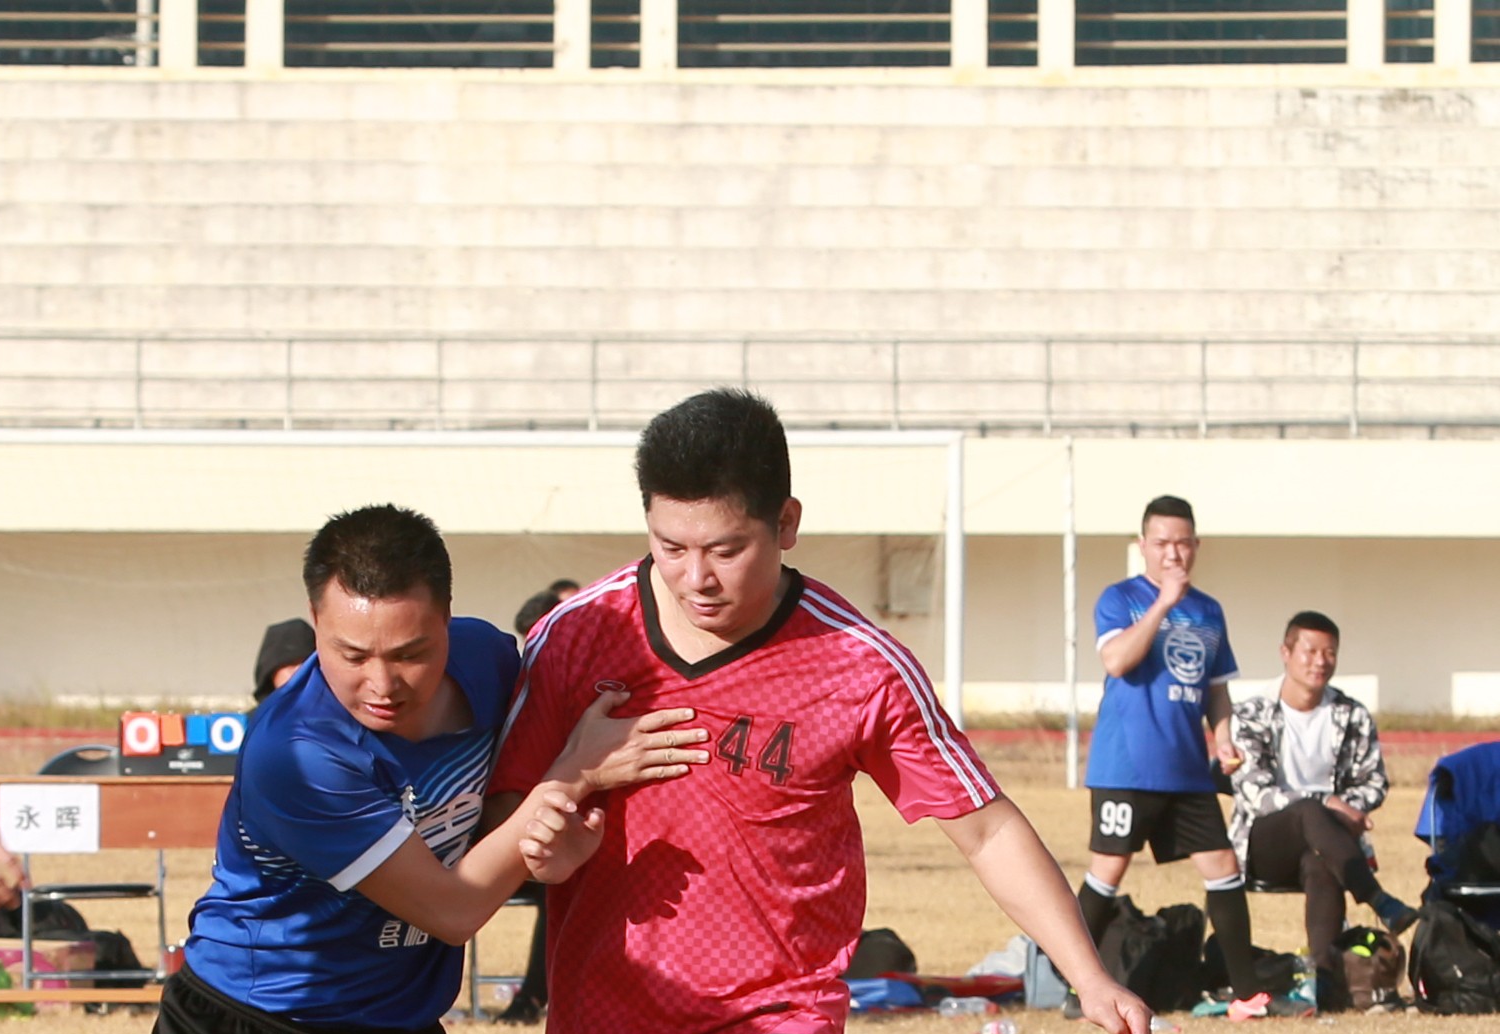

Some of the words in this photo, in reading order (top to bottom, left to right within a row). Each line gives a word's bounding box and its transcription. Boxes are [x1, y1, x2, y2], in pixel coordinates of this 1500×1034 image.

[125, 716, 160, 754] 0
[210, 715, 246, 752] 0
[714, 713, 797, 787] 44
[15, 804, 81, 830] 永晖
[1099, 800, 1133, 838] 99
